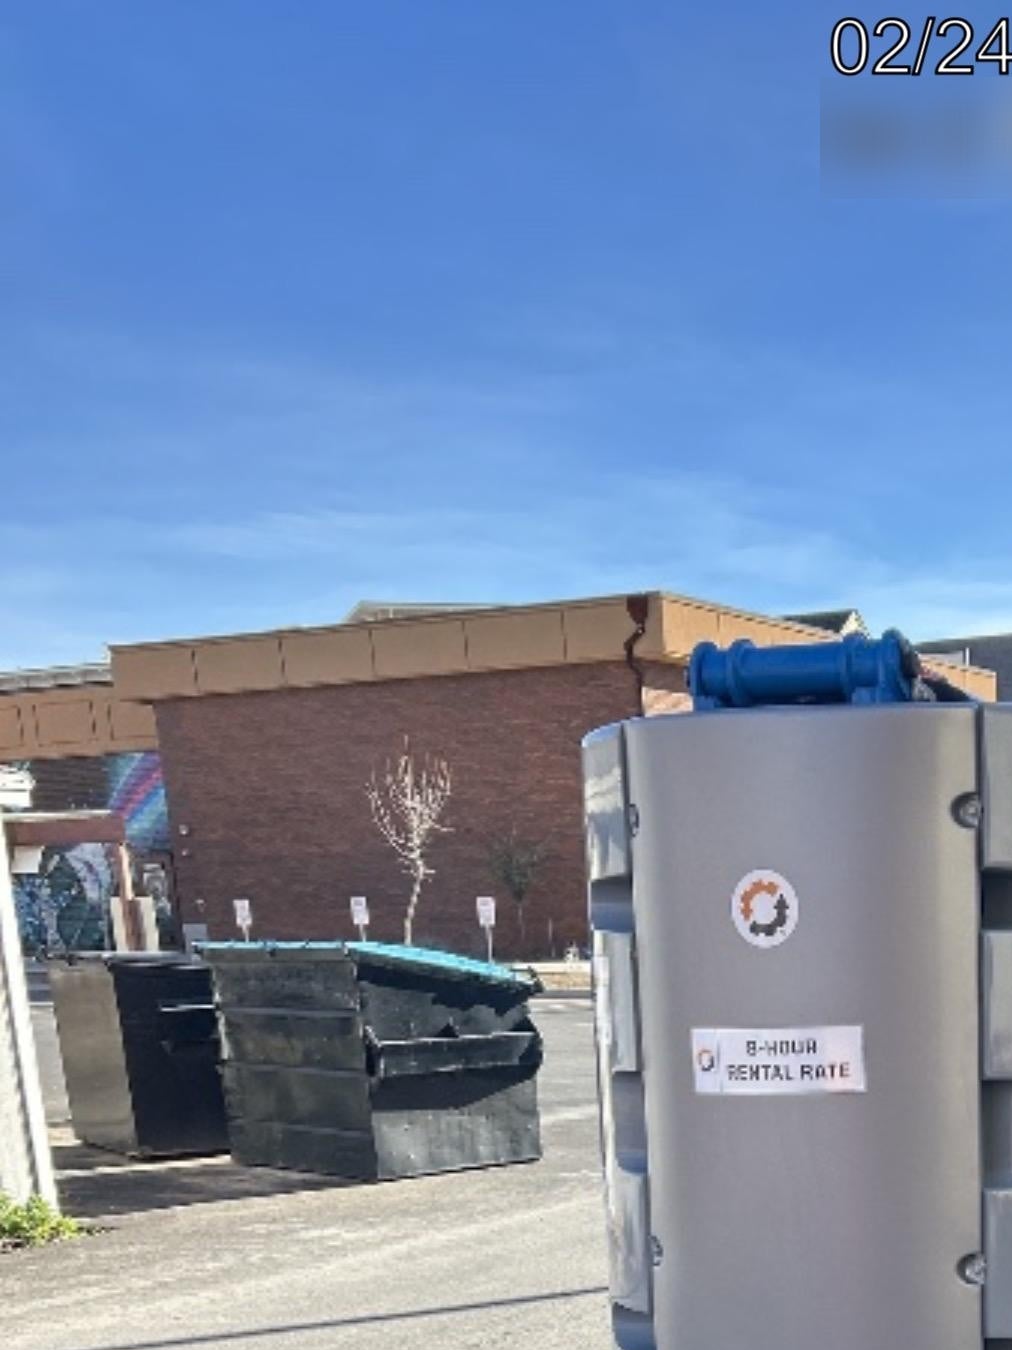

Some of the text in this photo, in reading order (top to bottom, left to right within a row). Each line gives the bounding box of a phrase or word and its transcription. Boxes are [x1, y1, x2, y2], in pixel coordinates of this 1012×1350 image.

[745, 1038, 818, 1057] 8-HOUR
[727, 1062, 851, 1081] RENTAL RATE
